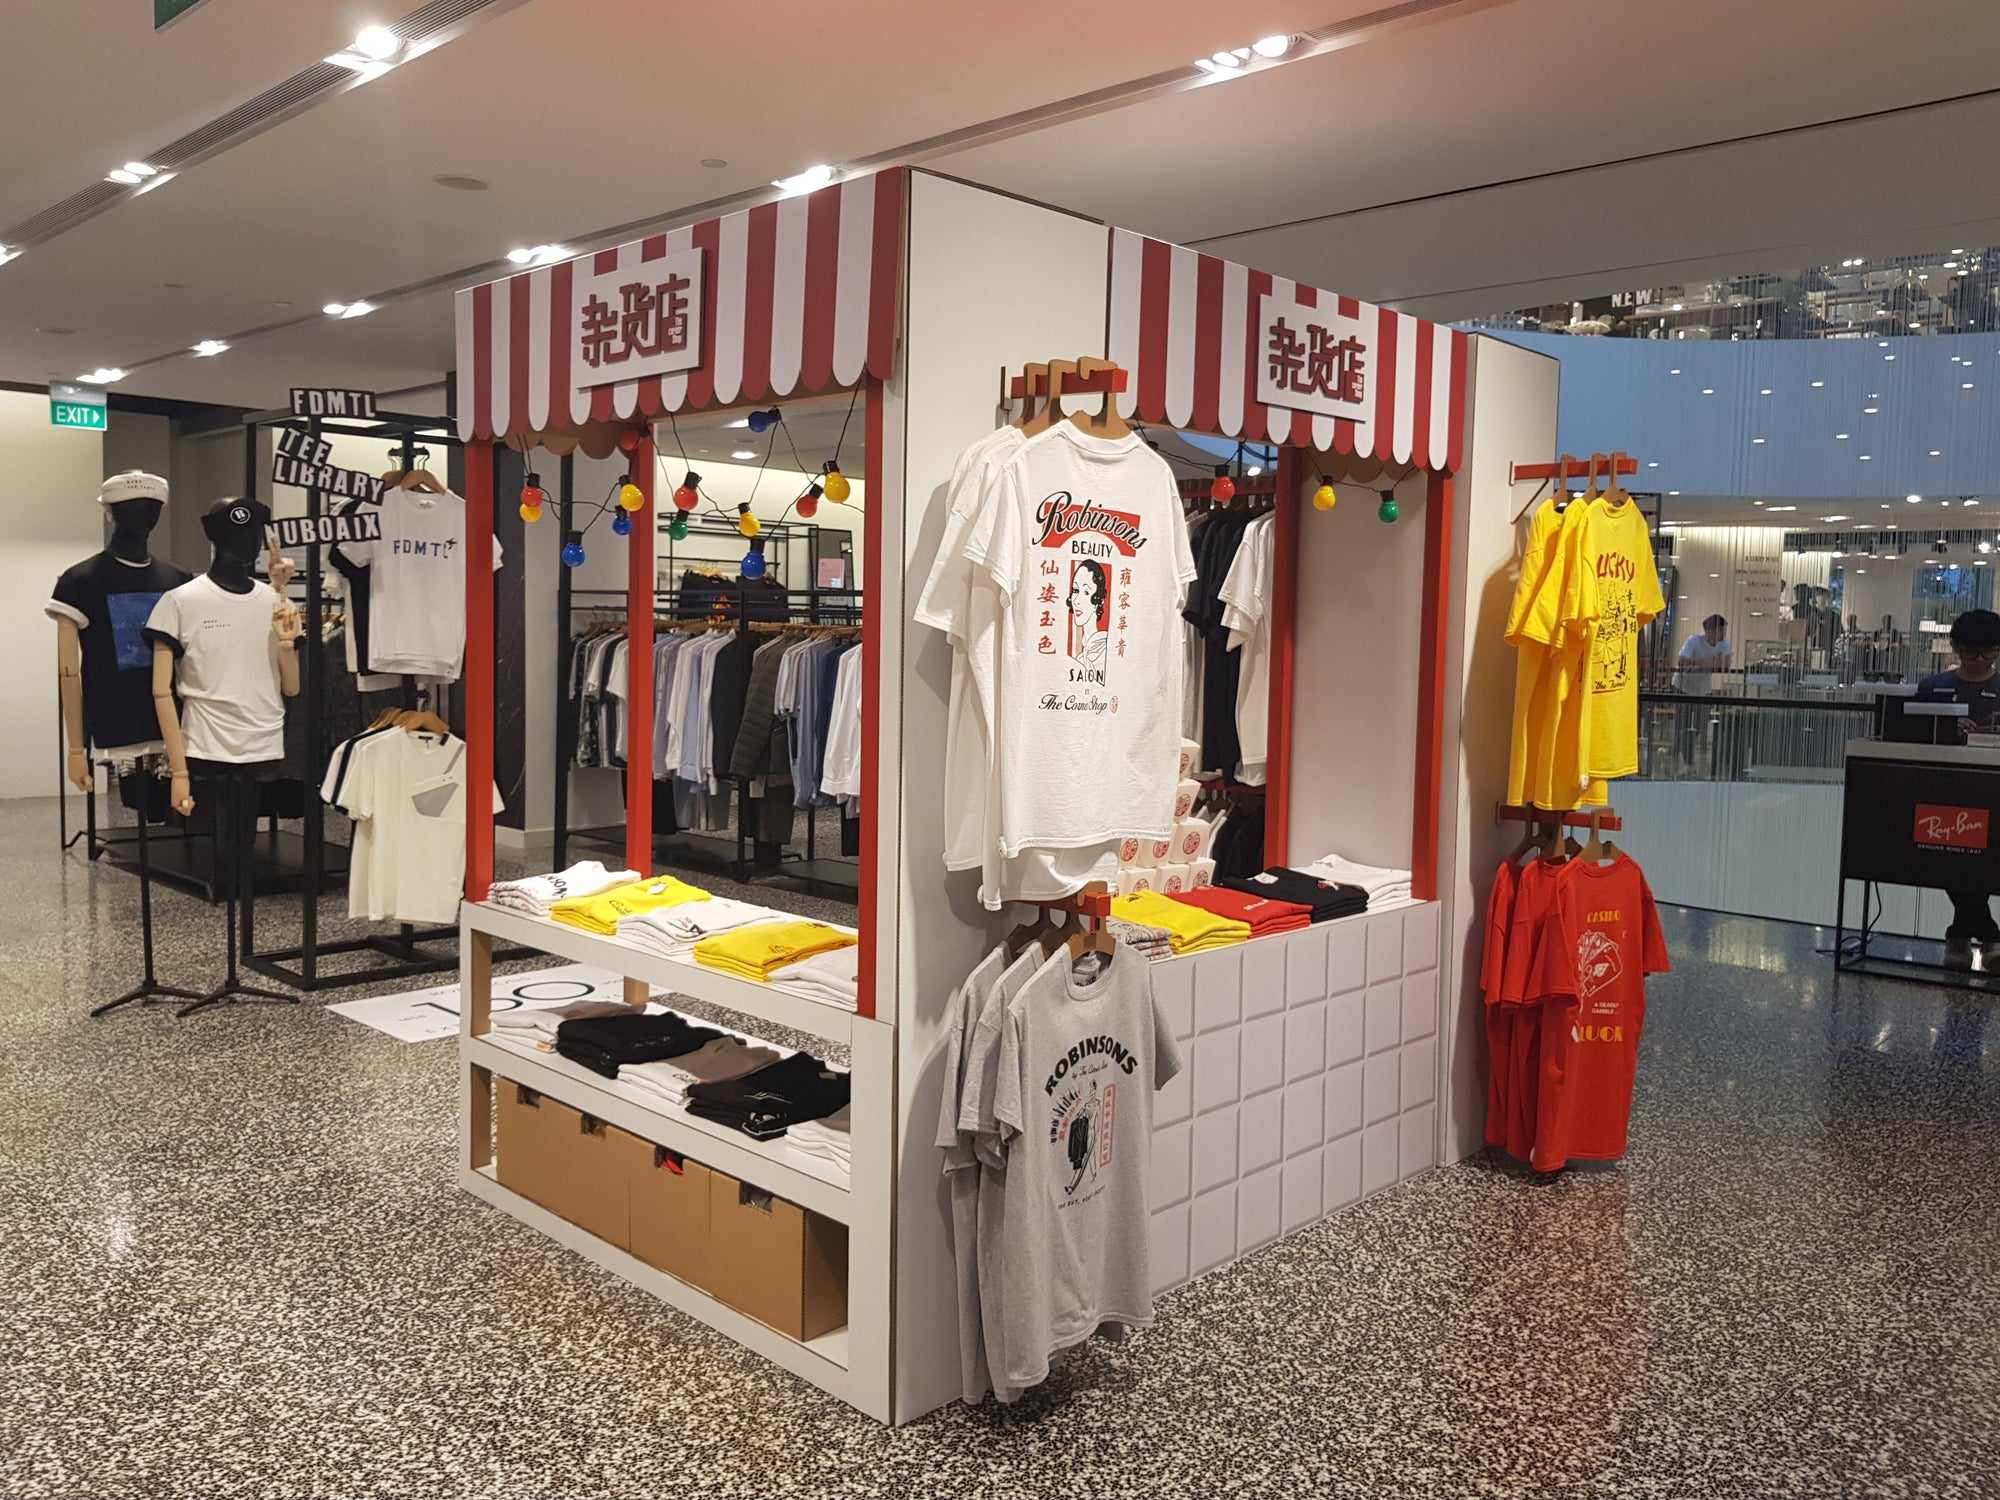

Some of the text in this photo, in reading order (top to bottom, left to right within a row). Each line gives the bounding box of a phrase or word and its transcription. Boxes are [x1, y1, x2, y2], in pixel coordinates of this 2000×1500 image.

[1612, 288, 1652, 307] NEW
[582, 273, 690, 367] 杂货店
[1269, 317, 1366, 403] 杂货店
[56, 405, 90, 424] EXIT
[293, 389, 375, 418] FDMTL
[284, 428, 329, 467] TEE
[274, 457, 384, 502] LIBRARY
[264, 514, 380, 545] NUBOAIX
[1032, 491, 1147, 549] Robinsons
[1071, 540, 1113, 558] BEAUTY
[1037, 559, 1059, 655] 仙姿玉色
[1069, 668, 1104, 682] SALON
[1038, 693, 1063, 710] The
[1089, 694, 1108, 715] Shop
[1586, 910, 1621, 923] CASINO
[1045, 1034, 1138, 1097] ROBINSONS
